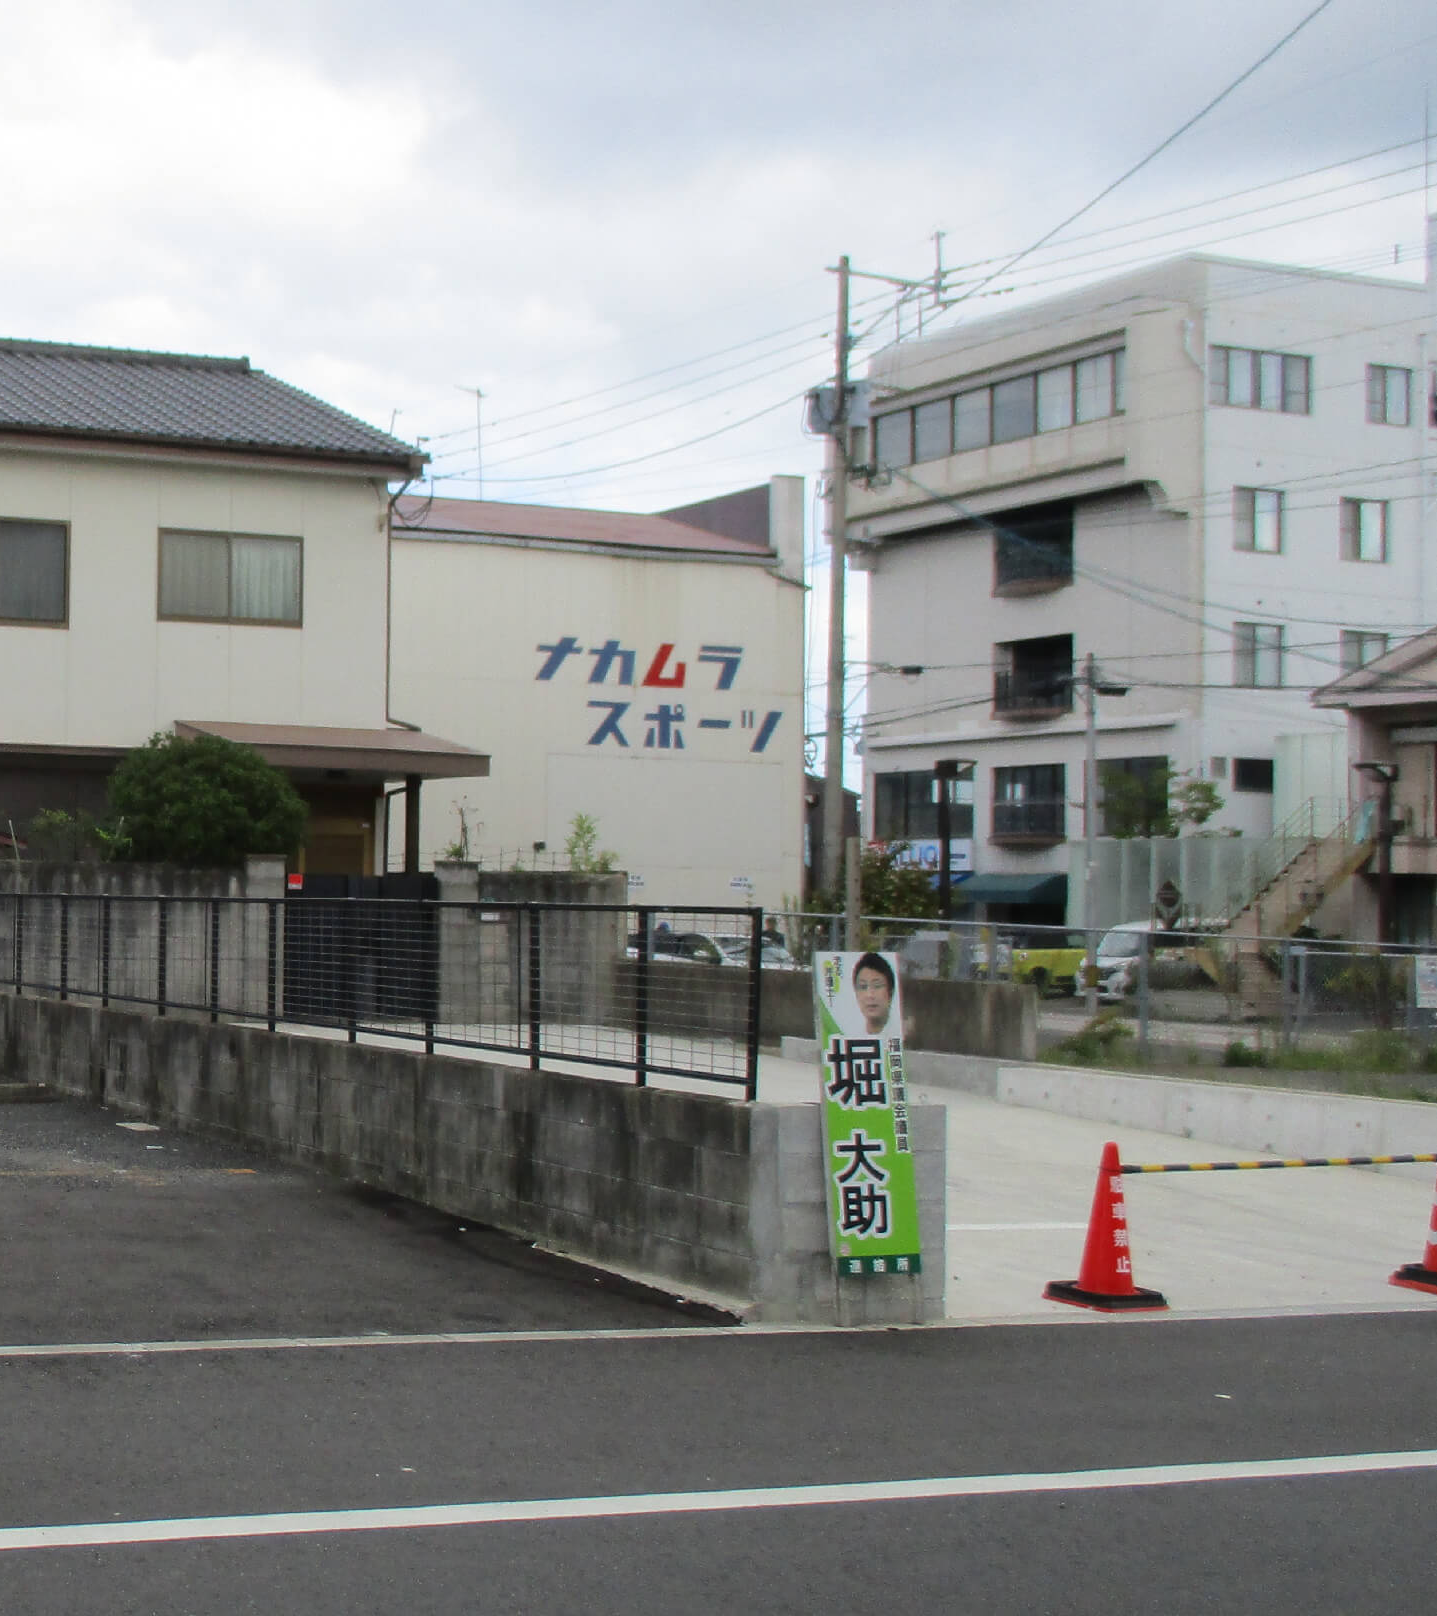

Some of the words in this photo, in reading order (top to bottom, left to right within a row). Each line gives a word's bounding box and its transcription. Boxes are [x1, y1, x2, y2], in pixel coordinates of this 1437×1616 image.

[534, 636, 744, 691] ナカムラ
[585, 699, 784, 753] スポーツ
